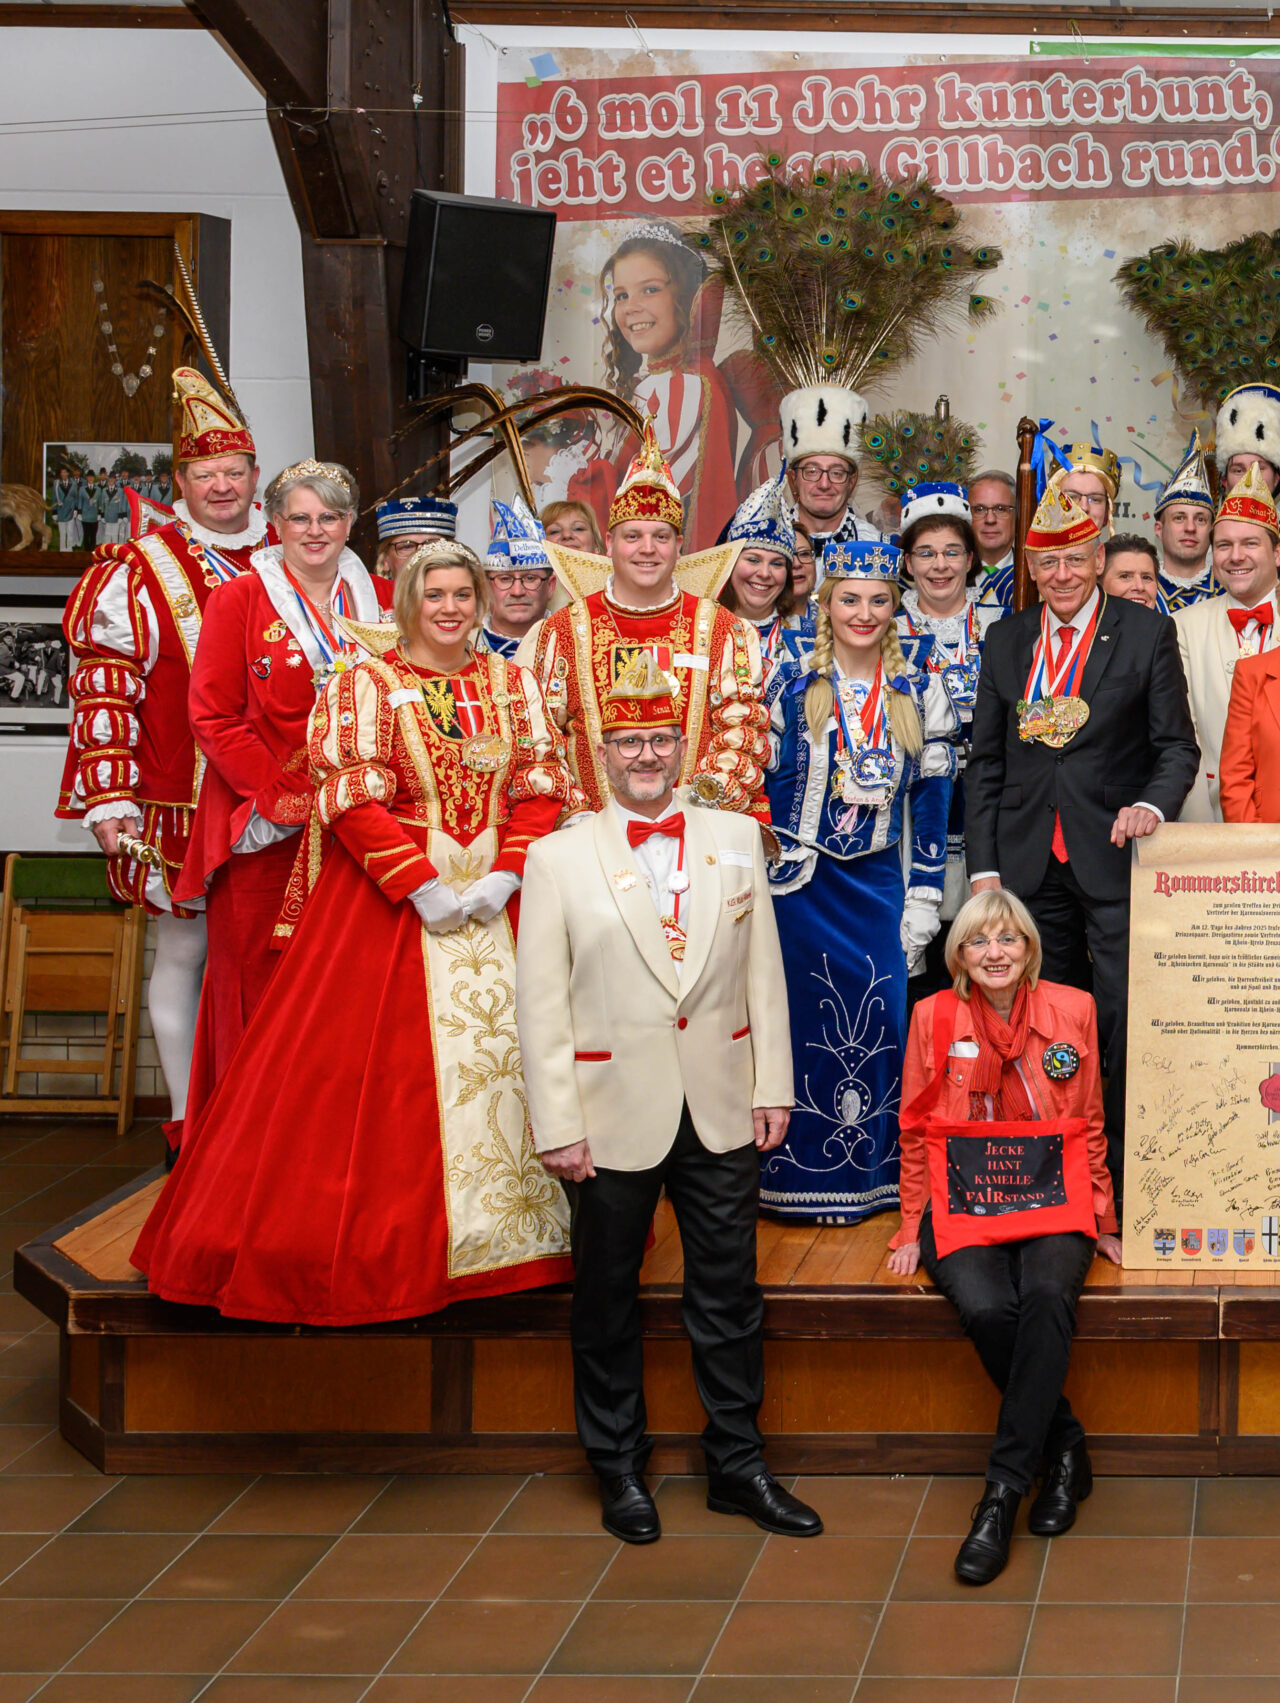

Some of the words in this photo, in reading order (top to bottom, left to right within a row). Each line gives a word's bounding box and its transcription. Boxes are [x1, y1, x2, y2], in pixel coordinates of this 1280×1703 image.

[599, 81, 703, 139] mol
[716, 84, 782, 136] 11
[793, 76, 926, 133] Johr
[936, 65, 1272, 130] kunterbunt,
[511, 149, 627, 205] jeht
[636, 149, 696, 201] et
[880, 133, 1112, 189] Gillbach
[1249, 505, 1267, 517] Senat
[984, 1142, 1025, 1156] JECKE
[987, 1160, 1022, 1171] HANT
[974, 1174, 1034, 1186] KAMELLE-
